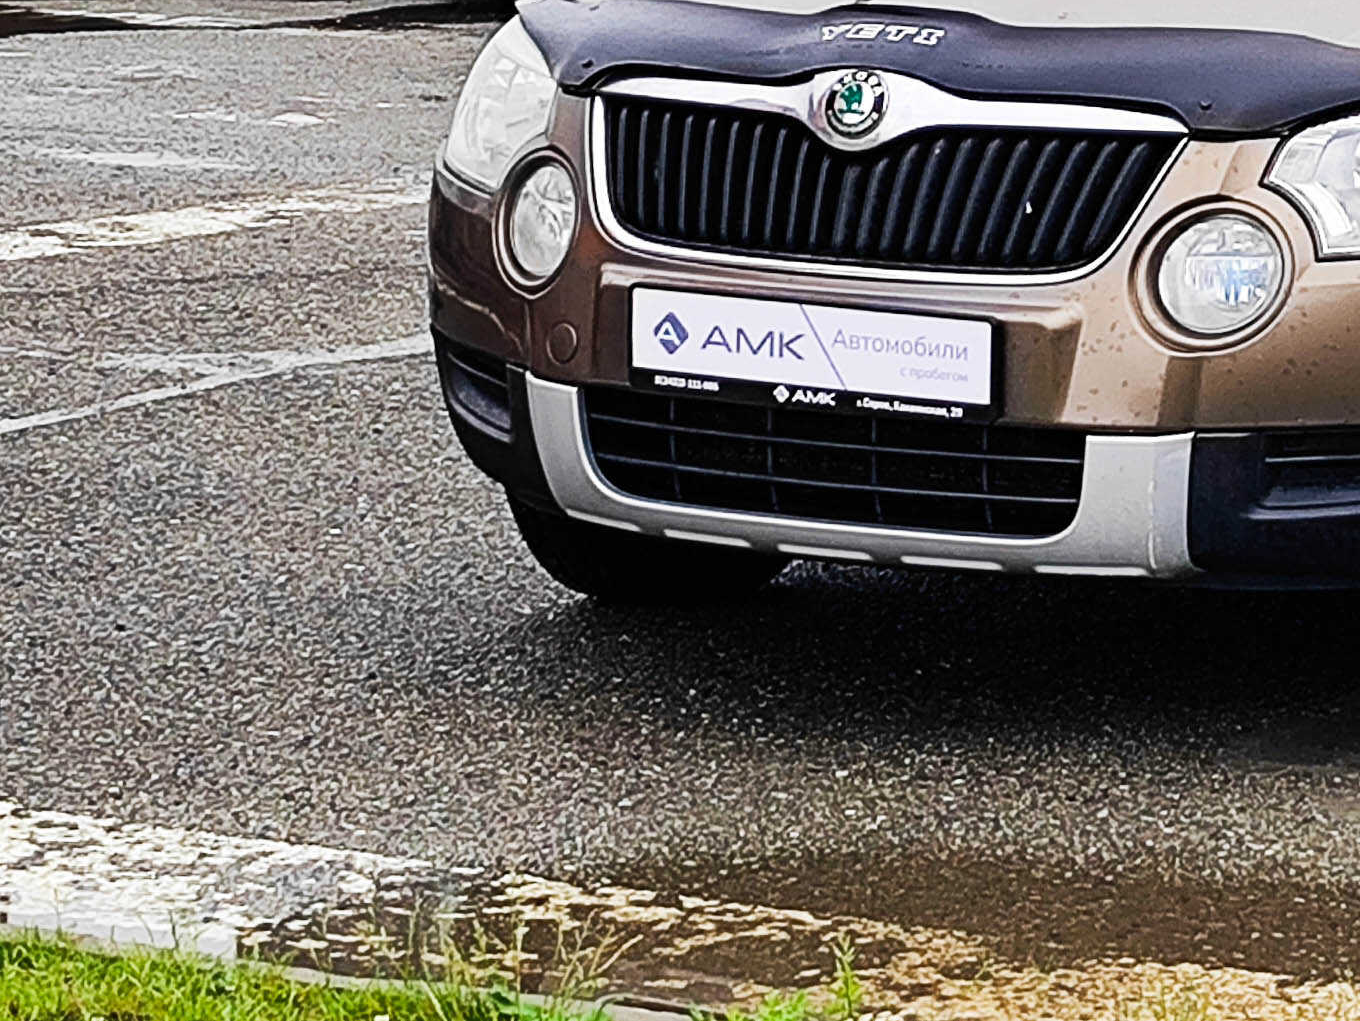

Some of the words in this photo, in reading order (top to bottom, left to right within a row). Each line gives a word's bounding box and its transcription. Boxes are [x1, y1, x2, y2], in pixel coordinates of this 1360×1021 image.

[701, 325, 805, 361] АМК
[832, 328, 968, 360] Автомобили
[792, 389, 836, 406] АМК
